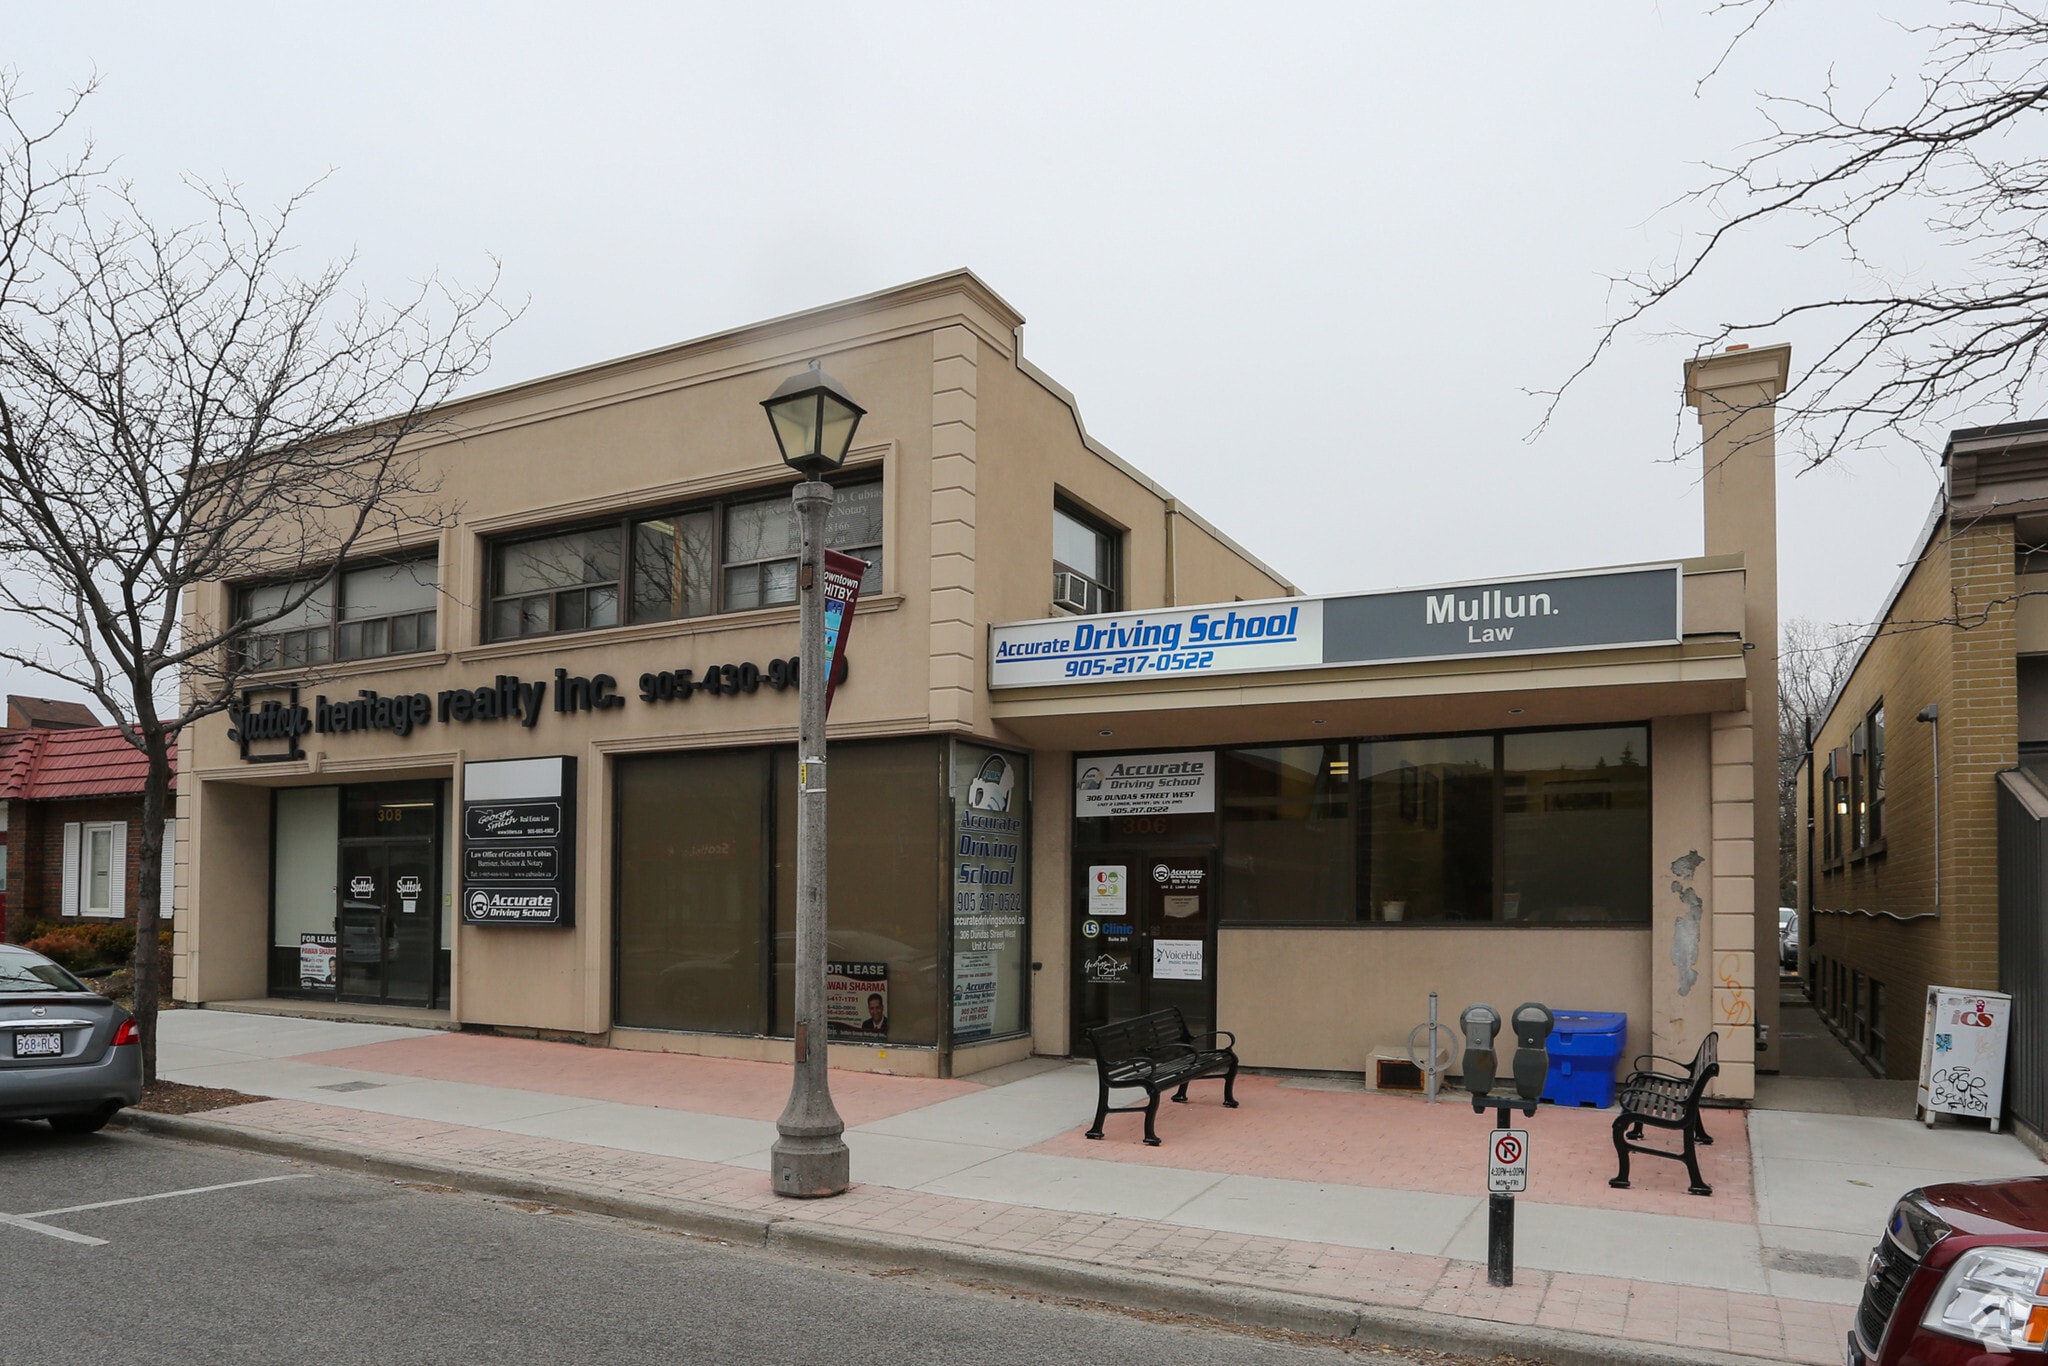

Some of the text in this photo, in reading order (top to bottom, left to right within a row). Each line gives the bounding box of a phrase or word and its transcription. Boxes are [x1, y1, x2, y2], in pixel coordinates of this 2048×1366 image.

[837, 505, 867, 516] Notary
[824, 571, 858, 588] owntown
[824, 582, 853, 601] HITBY
[1426, 590, 1559, 624] Mullun.
[996, 606, 1299, 656] Accurate Driving School
[1469, 626, 1514, 643] Law
[1064, 650, 1214, 678] 905-217-0522
[228, 699, 312, 743] Sutton
[315, 690, 431, 737] heritage
[438, 675, 546, 727] realty
[554, 668, 625, 712] inc.
[1110, 762, 1204, 776] Accurate
[1110, 777, 1201, 789] Driving School
[378, 809, 402, 821] 308
[1110, 806, 1168, 814] 905.217.0522
[478, 810, 514, 824] George
[961, 810, 1020, 830] Accurate
[486, 816, 518, 832] Smith
[1123, 818, 1167, 834] 306
[959, 834, 1018, 864] Driving
[526, 860, 543, 868] Notary
[959, 863, 1015, 884] School
[350, 880, 375, 892] Sutton
[396, 880, 422, 893] Sutton
[490, 894, 552, 906] Accurate
[957, 892, 1021, 912] 905 217-0522
[490, 909, 551, 918] Driving School
[960, 931, 969, 939] 306
[971, 930, 989, 939] Dundas
[990, 930, 1004, 938] Street
[1086, 923, 1133, 934] LS Clinic
[972, 942, 982, 950] Unit
[982, 942, 986, 950] 2
[1165, 950, 1202, 960] VoiceHub
[827, 964, 884, 975] OR LEASE
[827, 981, 886, 992] WAN SHARMA
[965, 981, 996, 991] Accurate
